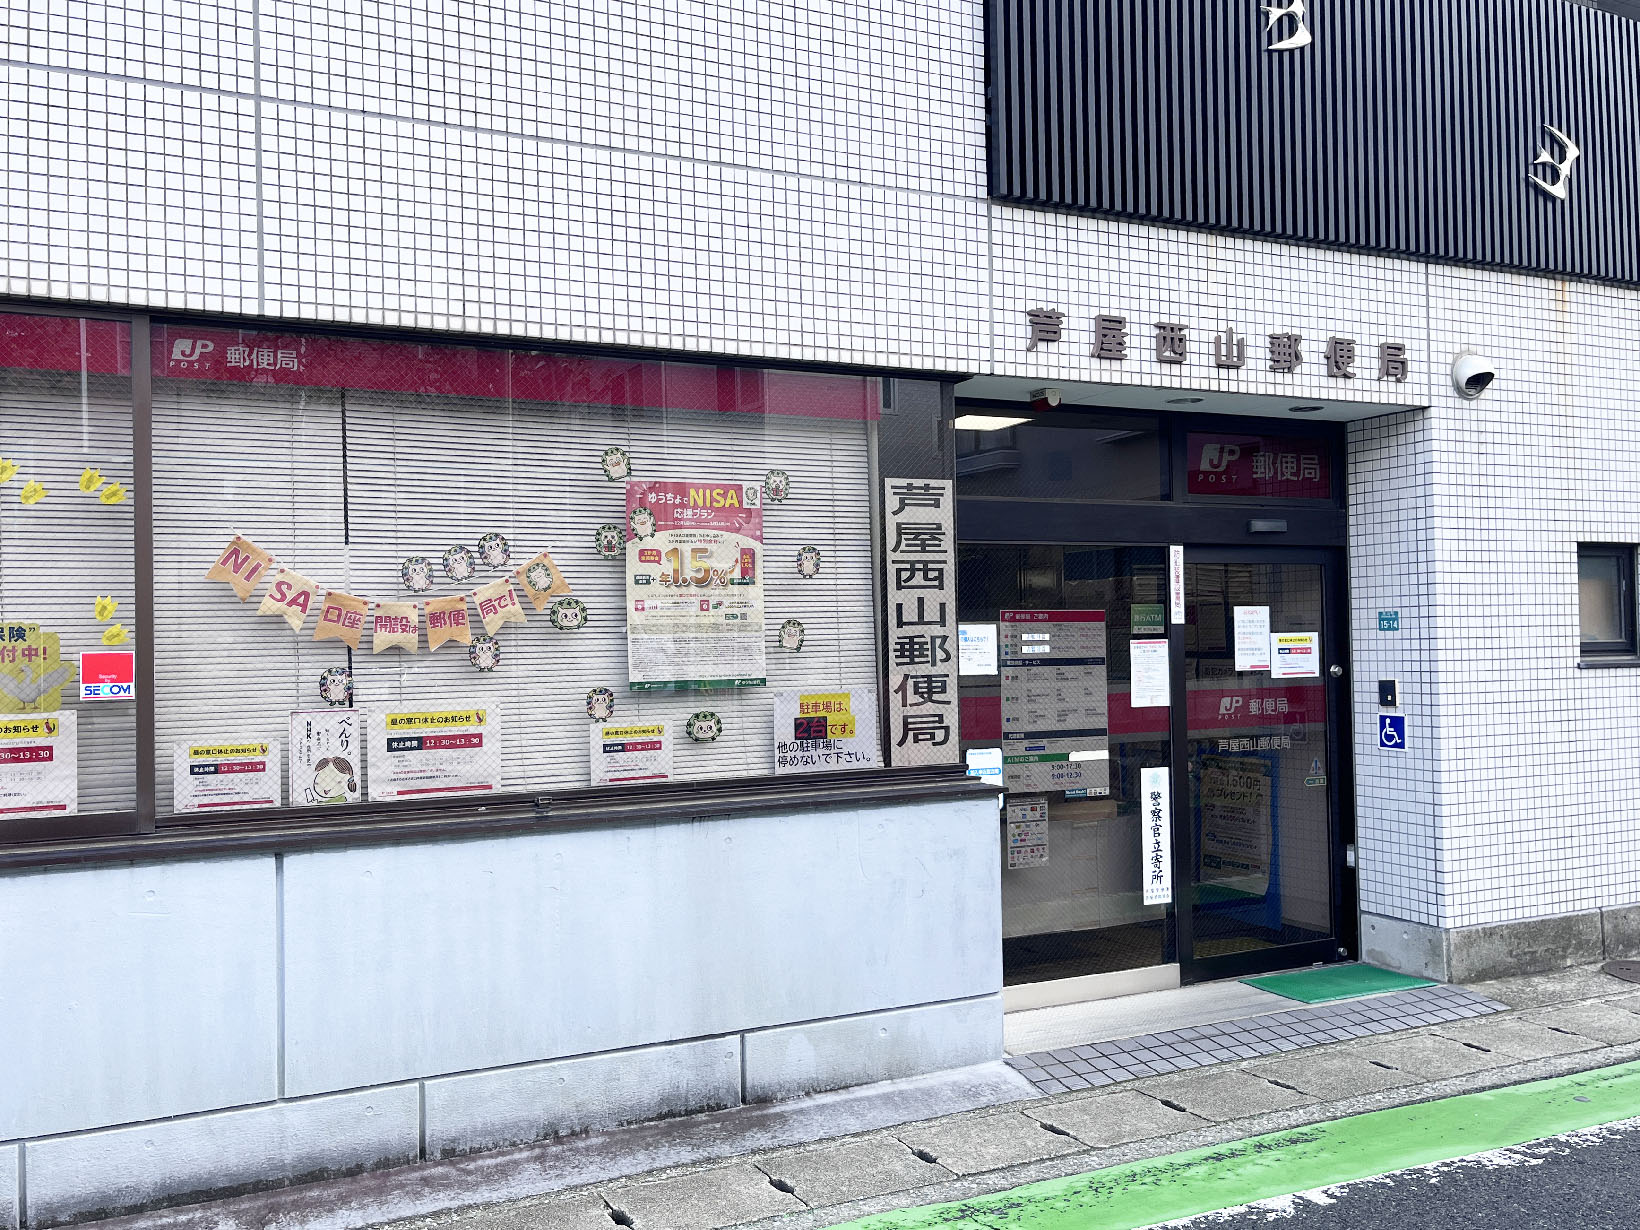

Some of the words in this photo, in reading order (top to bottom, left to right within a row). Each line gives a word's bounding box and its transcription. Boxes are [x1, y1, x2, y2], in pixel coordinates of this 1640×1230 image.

[1026, 306, 1409, 382] 芦屋西山郵便局
[169, 360, 211, 370] POST
[226, 346, 298, 371] 郵便局
[1252, 451, 1321, 482] 郵便局
[1197, 474, 1239, 483] POST
[648, 492, 689, 505] ゆうちょで
[689, 487, 740, 508] NISA
[673, 508, 715, 519] 応援プラン
[322, 605, 364, 630] 口座
[373, 615, 418, 634] 開設は
[428, 608, 467, 630] 郵便
[890, 482, 952, 748] 芦屋西山郵便局
[1380, 620, 1398, 629] 15-14
[0, 625, 36, 643] 険”
[84, 684, 131, 696] SECOM
[799, 700, 848, 715] 駐車場は、
[1248, 697, 1289, 716] 郵便局
[390, 715, 472, 726] 昼の窓口休止のお知らせ
[776, 739, 844, 755] 他の駐車場に
[1217, 736, 1291, 752] 芦屋西山郵便局
[776, 750, 872, 768] 停めないで下さい。
[1149, 790, 1164, 886] 警察官立寄所
